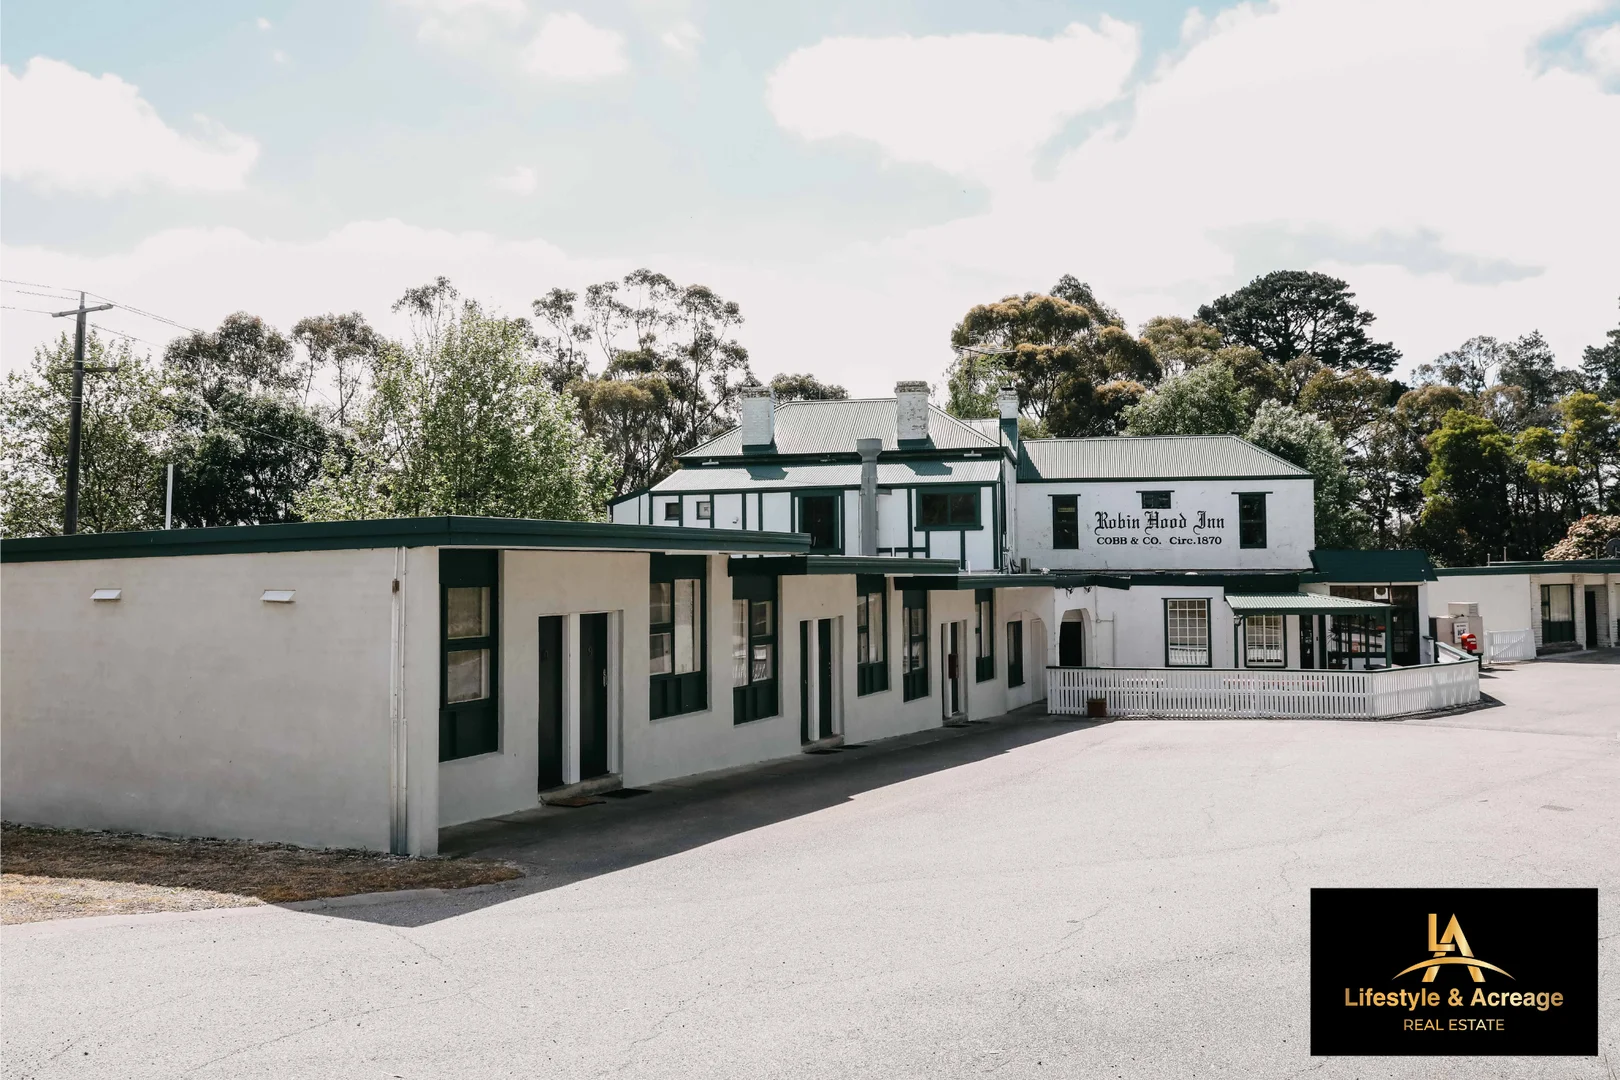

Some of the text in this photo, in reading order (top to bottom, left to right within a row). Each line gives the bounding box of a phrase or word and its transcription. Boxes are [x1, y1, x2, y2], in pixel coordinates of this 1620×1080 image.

[1094, 510, 1225, 535] Robin Hood Inn
[1096, 536, 1128, 545] COBB
[1130, 536, 1139, 545] &
[1142, 536, 1162, 545] CO.
